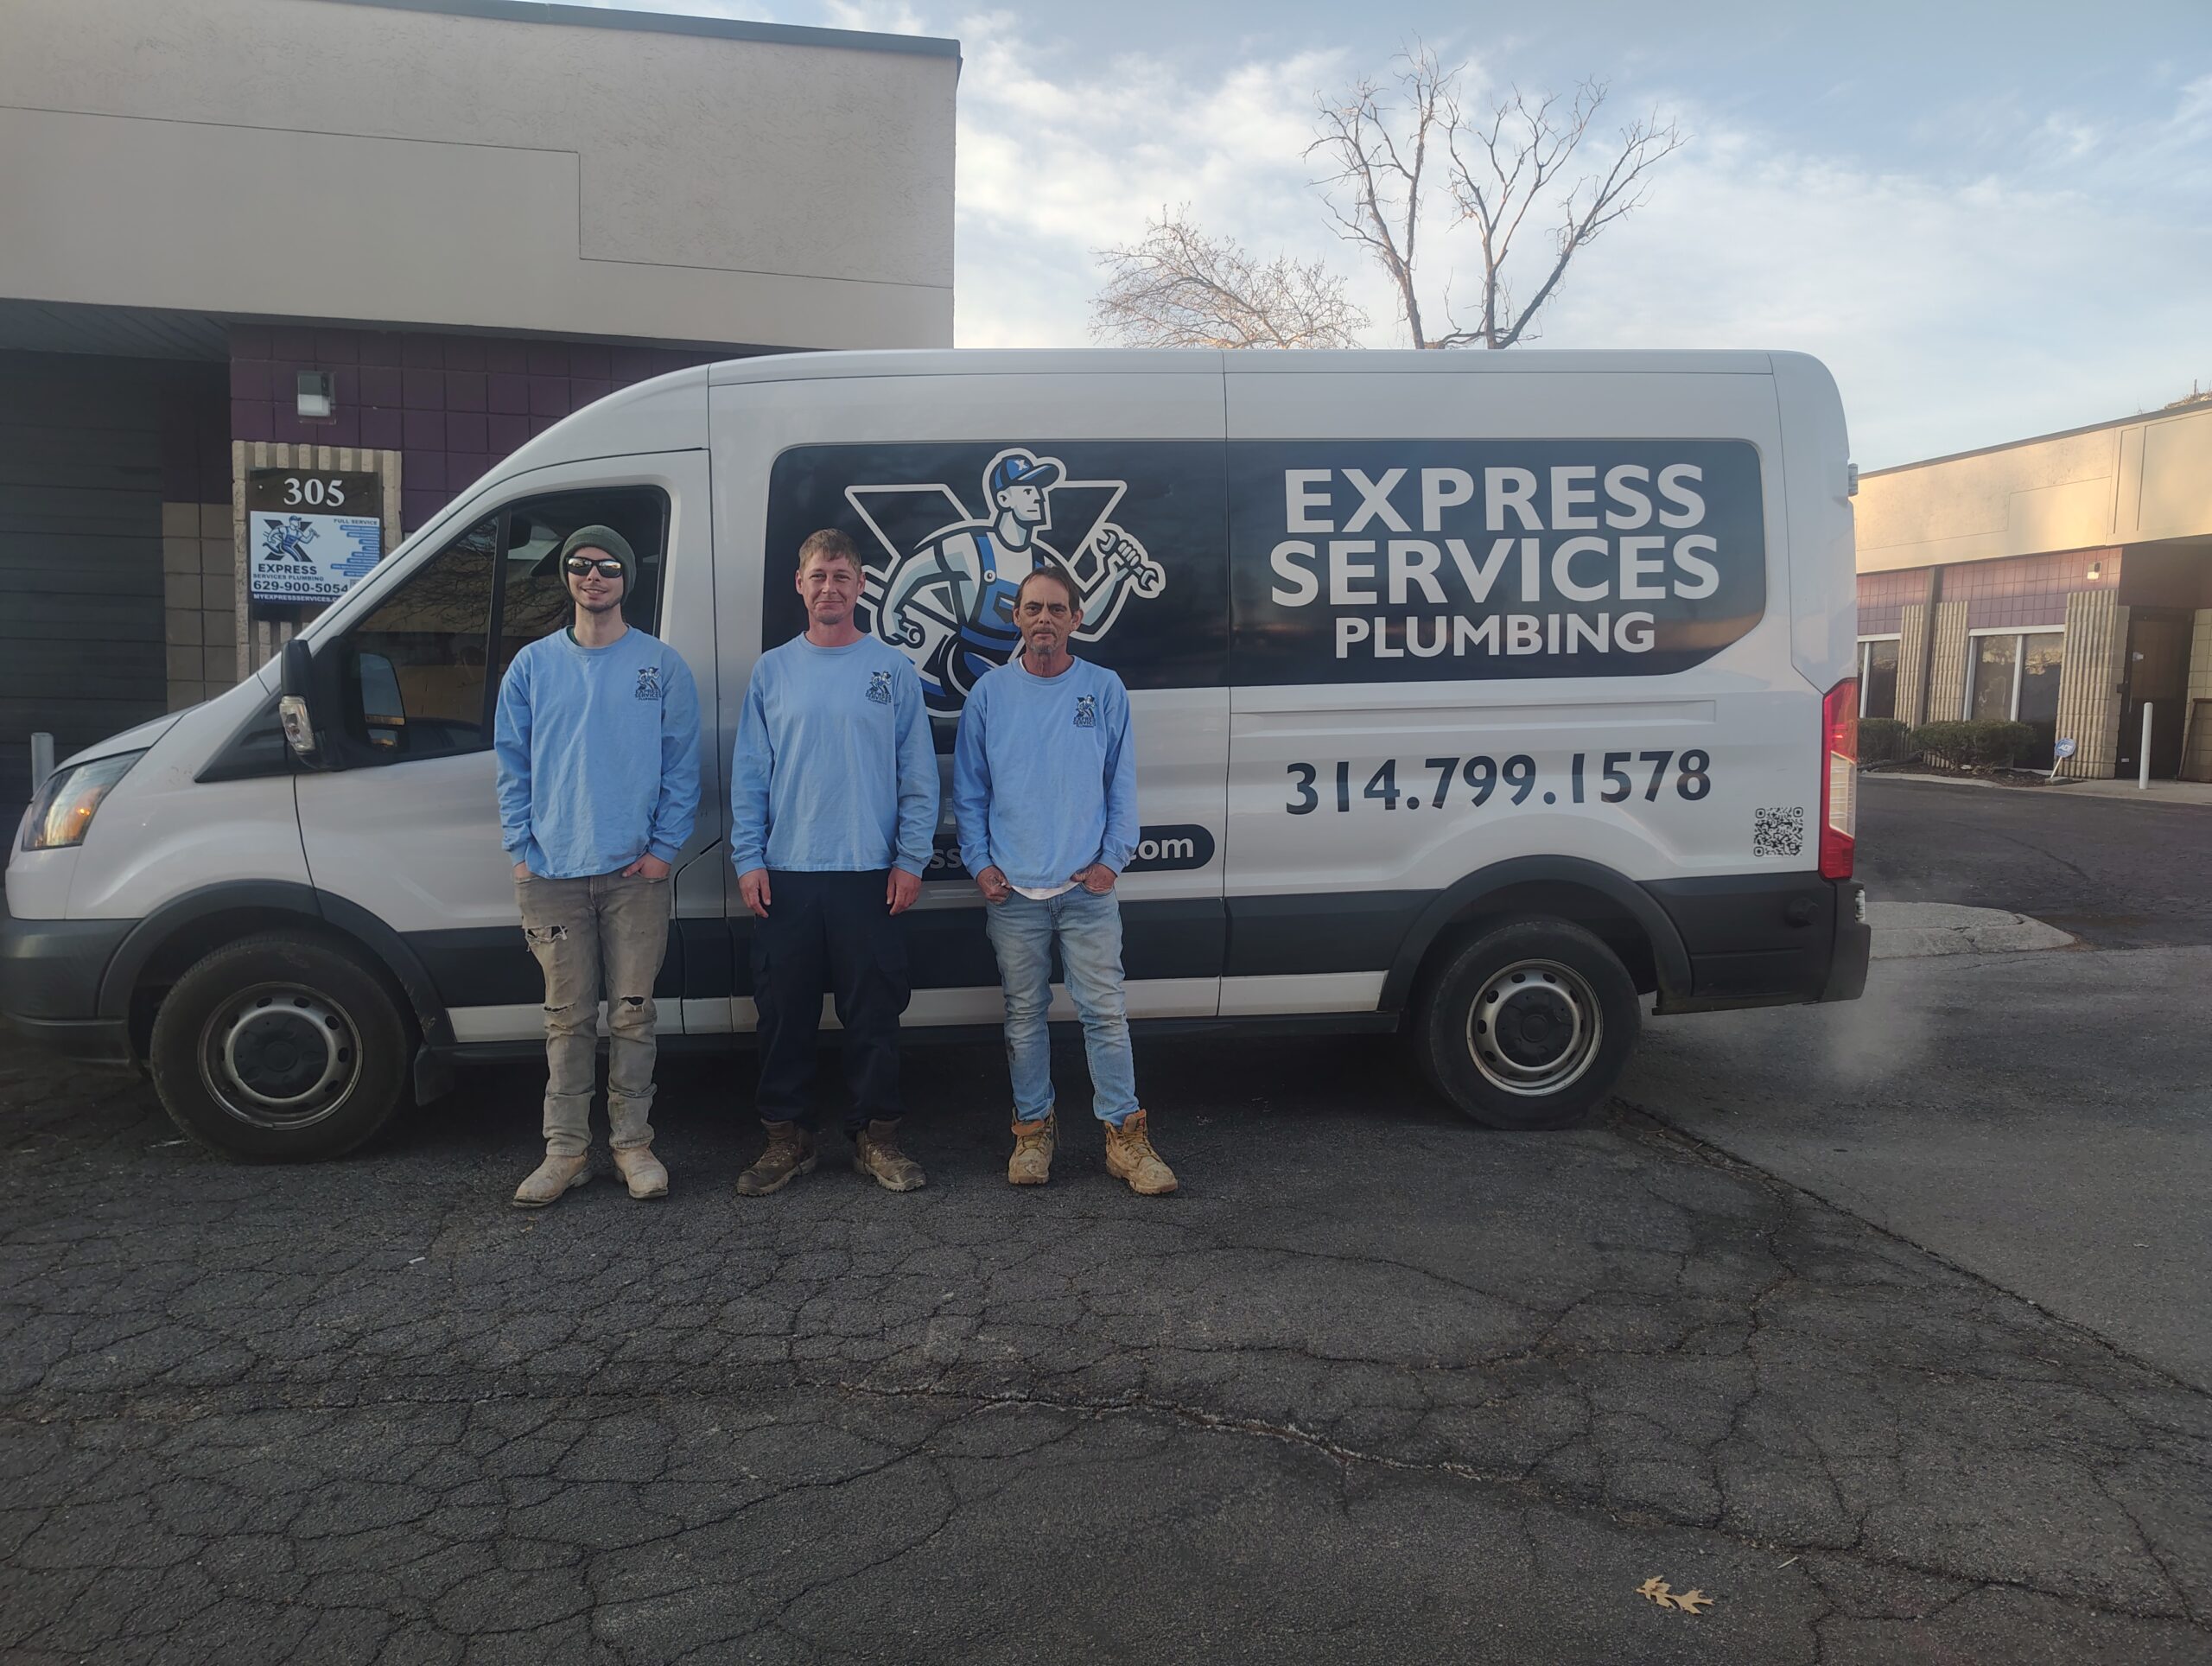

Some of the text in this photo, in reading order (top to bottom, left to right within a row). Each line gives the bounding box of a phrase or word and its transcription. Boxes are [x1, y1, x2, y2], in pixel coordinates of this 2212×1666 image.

[283, 478, 345, 506] 305
[1284, 463, 1707, 533] EXPRESS
[258, 563, 317, 575] EXPRESS
[1270, 534, 1719, 607] SERVICES
[253, 581, 348, 594] 629-900-5054
[253, 594, 339, 602] MYEXPRESSSERVICES.C
[1335, 612, 1656, 658] PLUMBING
[1285, 749, 1712, 815] 314.799.1578
[1129, 838, 1194, 860] om
